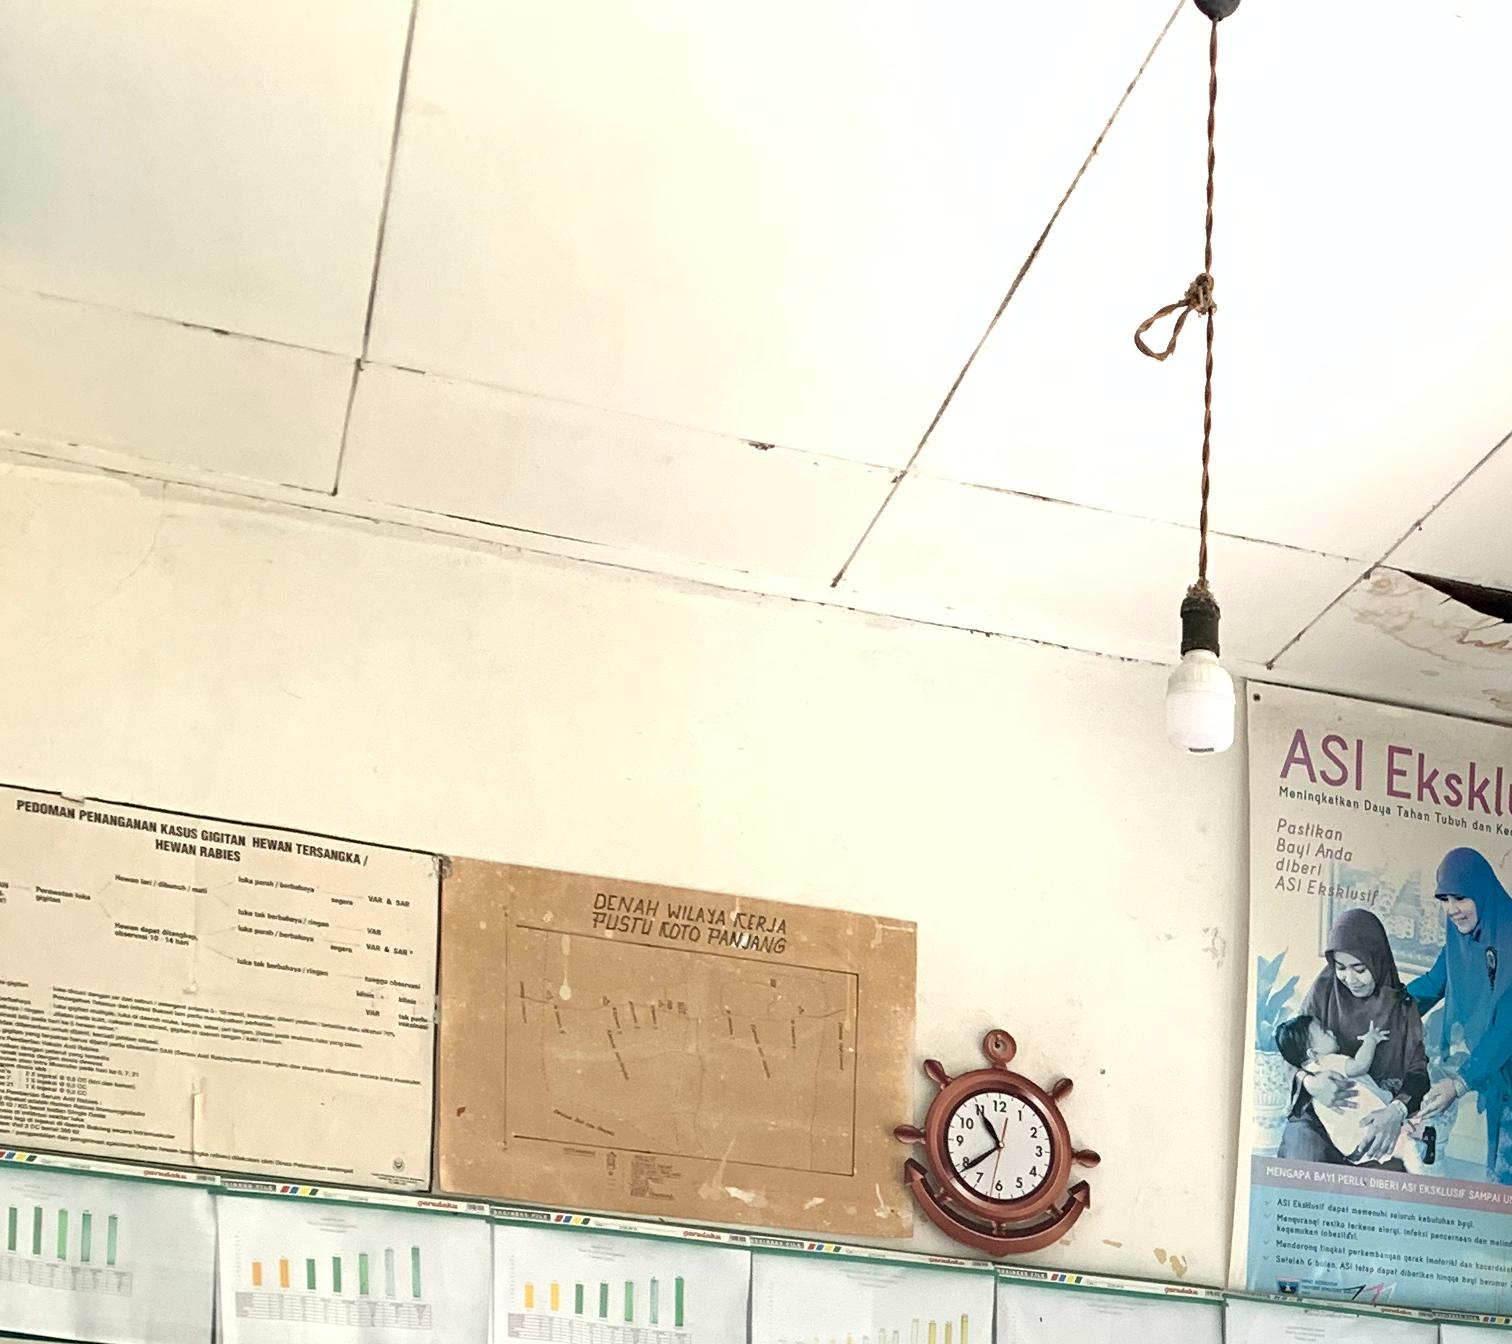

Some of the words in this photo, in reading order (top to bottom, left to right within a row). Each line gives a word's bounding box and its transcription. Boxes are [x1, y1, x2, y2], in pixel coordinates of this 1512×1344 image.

[1279, 727, 1363, 792] ASI
[1279, 784, 1360, 810] Meningkatkan
[1364, 797, 1392, 817] Daya
[1396, 804, 1430, 822] Tahan
[1434, 811, 1467, 829] Tubuh
[1472, 818, 1492, 834] dan
[16, 800, 75, 819] PEDOMAN
[79, 810, 157, 832] PENANGANAN
[161, 824, 197, 839] KASUS
[200, 830, 246, 846] GIGITAN
[252, 836, 292, 853] HEWAN
[295, 843, 361, 865] TERSANGKA
[1276, 817, 1343, 842] Pastikan
[155, 839, 196, 855] HEWAN
[200, 848, 241, 862] RABIES
[1276, 837, 1311, 859] Bayi
[1315, 843, 1353, 862] Anda
[1275, 858, 1322, 876] diberi
[1274, 876, 1301, 893] ASI
[1307, 879, 1380, 906] Eksklusif
[368, 895, 383, 904] VAR
[395, 899, 410, 908] SAR
[594, 893, 659, 917] DENAH
[667, 903, 726, 926] WILAYA
[733, 912, 786, 934] KERJA
[367, 927, 382, 936] VAR
[592, 911, 652, 936] PUSTU
[658, 921, 700, 943] KOTO
[707, 927, 787, 954] PANJANG
[366, 943, 381, 952] VAR
[993, 1100, 1007, 1113] 12
[1018, 1110, 1022, 1121] 1
[960, 1118, 974, 1129] 10
[1031, 1127, 1037, 1139] 2
[956, 1135, 964, 1146] 9
[1036, 1146, 1042, 1157] 3
[962, 1156, 970, 1168] 8
[976, 1172, 984, 1183] 7
[1029, 1166, 1037, 1177] 4
[995, 1180, 1003, 1191] 6
[1016, 1177, 1023, 1188] 5
[1266, 1166, 1311, 1181] MENGAPA
[1314, 1171, 1335, 1184] BAYI
[1369, 1178, 1399, 1191] DIBERI
[1401, 1181, 1417, 1193] ASI
[1419, 1185, 1466, 1200] EKSKLUSIF
[1468, 1190, 1501, 1202] SAMPAI
